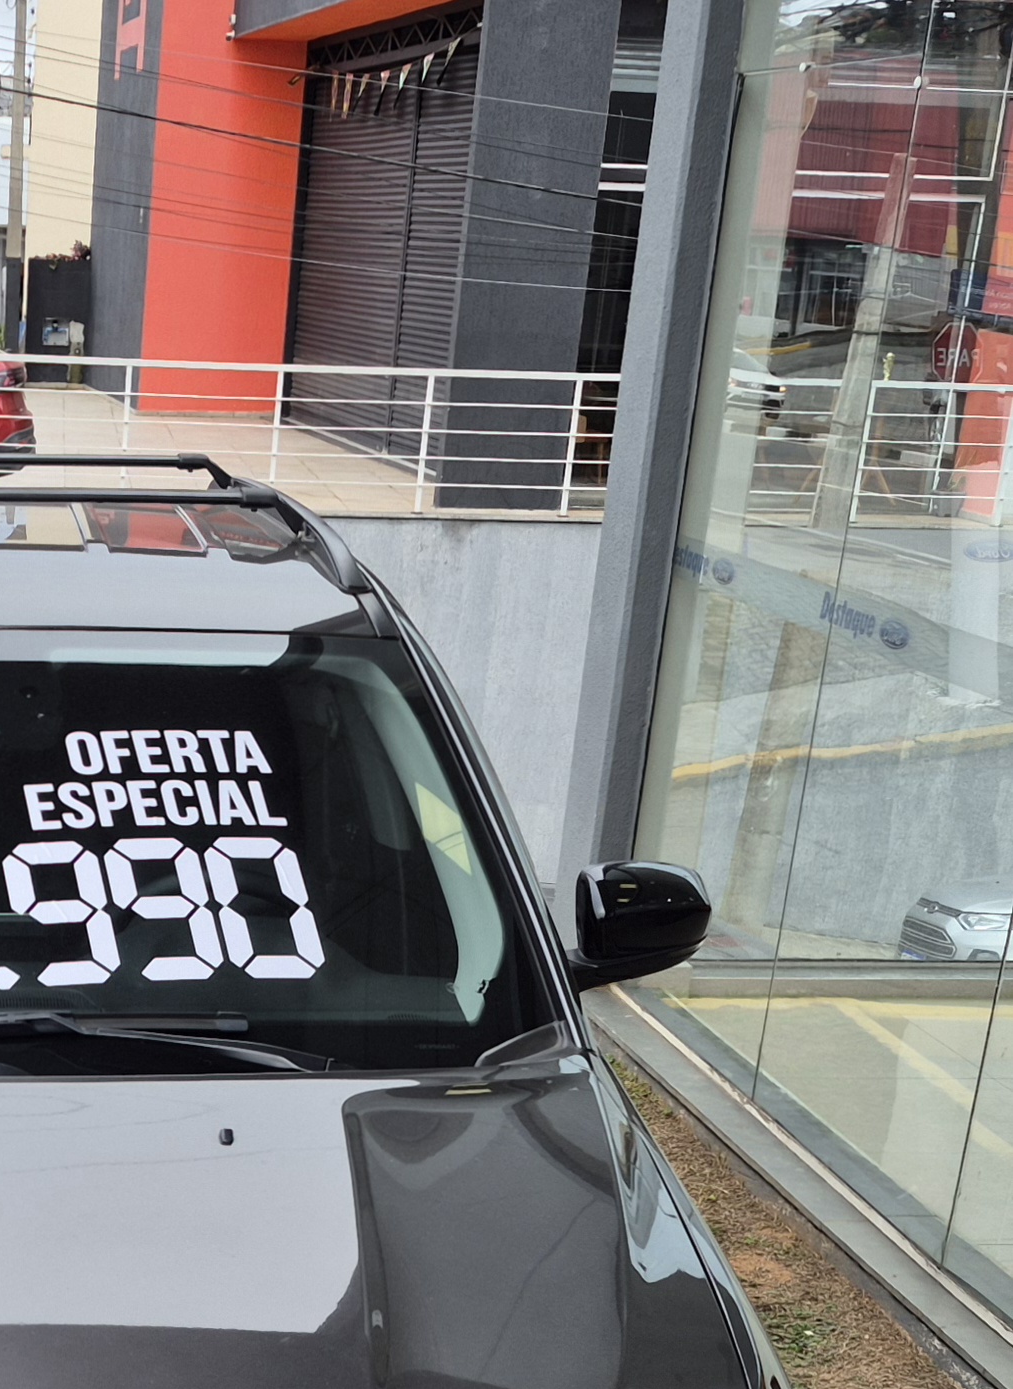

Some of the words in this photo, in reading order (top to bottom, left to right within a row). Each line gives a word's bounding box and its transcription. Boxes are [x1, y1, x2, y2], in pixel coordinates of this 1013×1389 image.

[819, 591, 876, 639] Destaque
[65, 730, 273, 775] OFERTA
[23, 780, 288, 831] ESPECIAL
